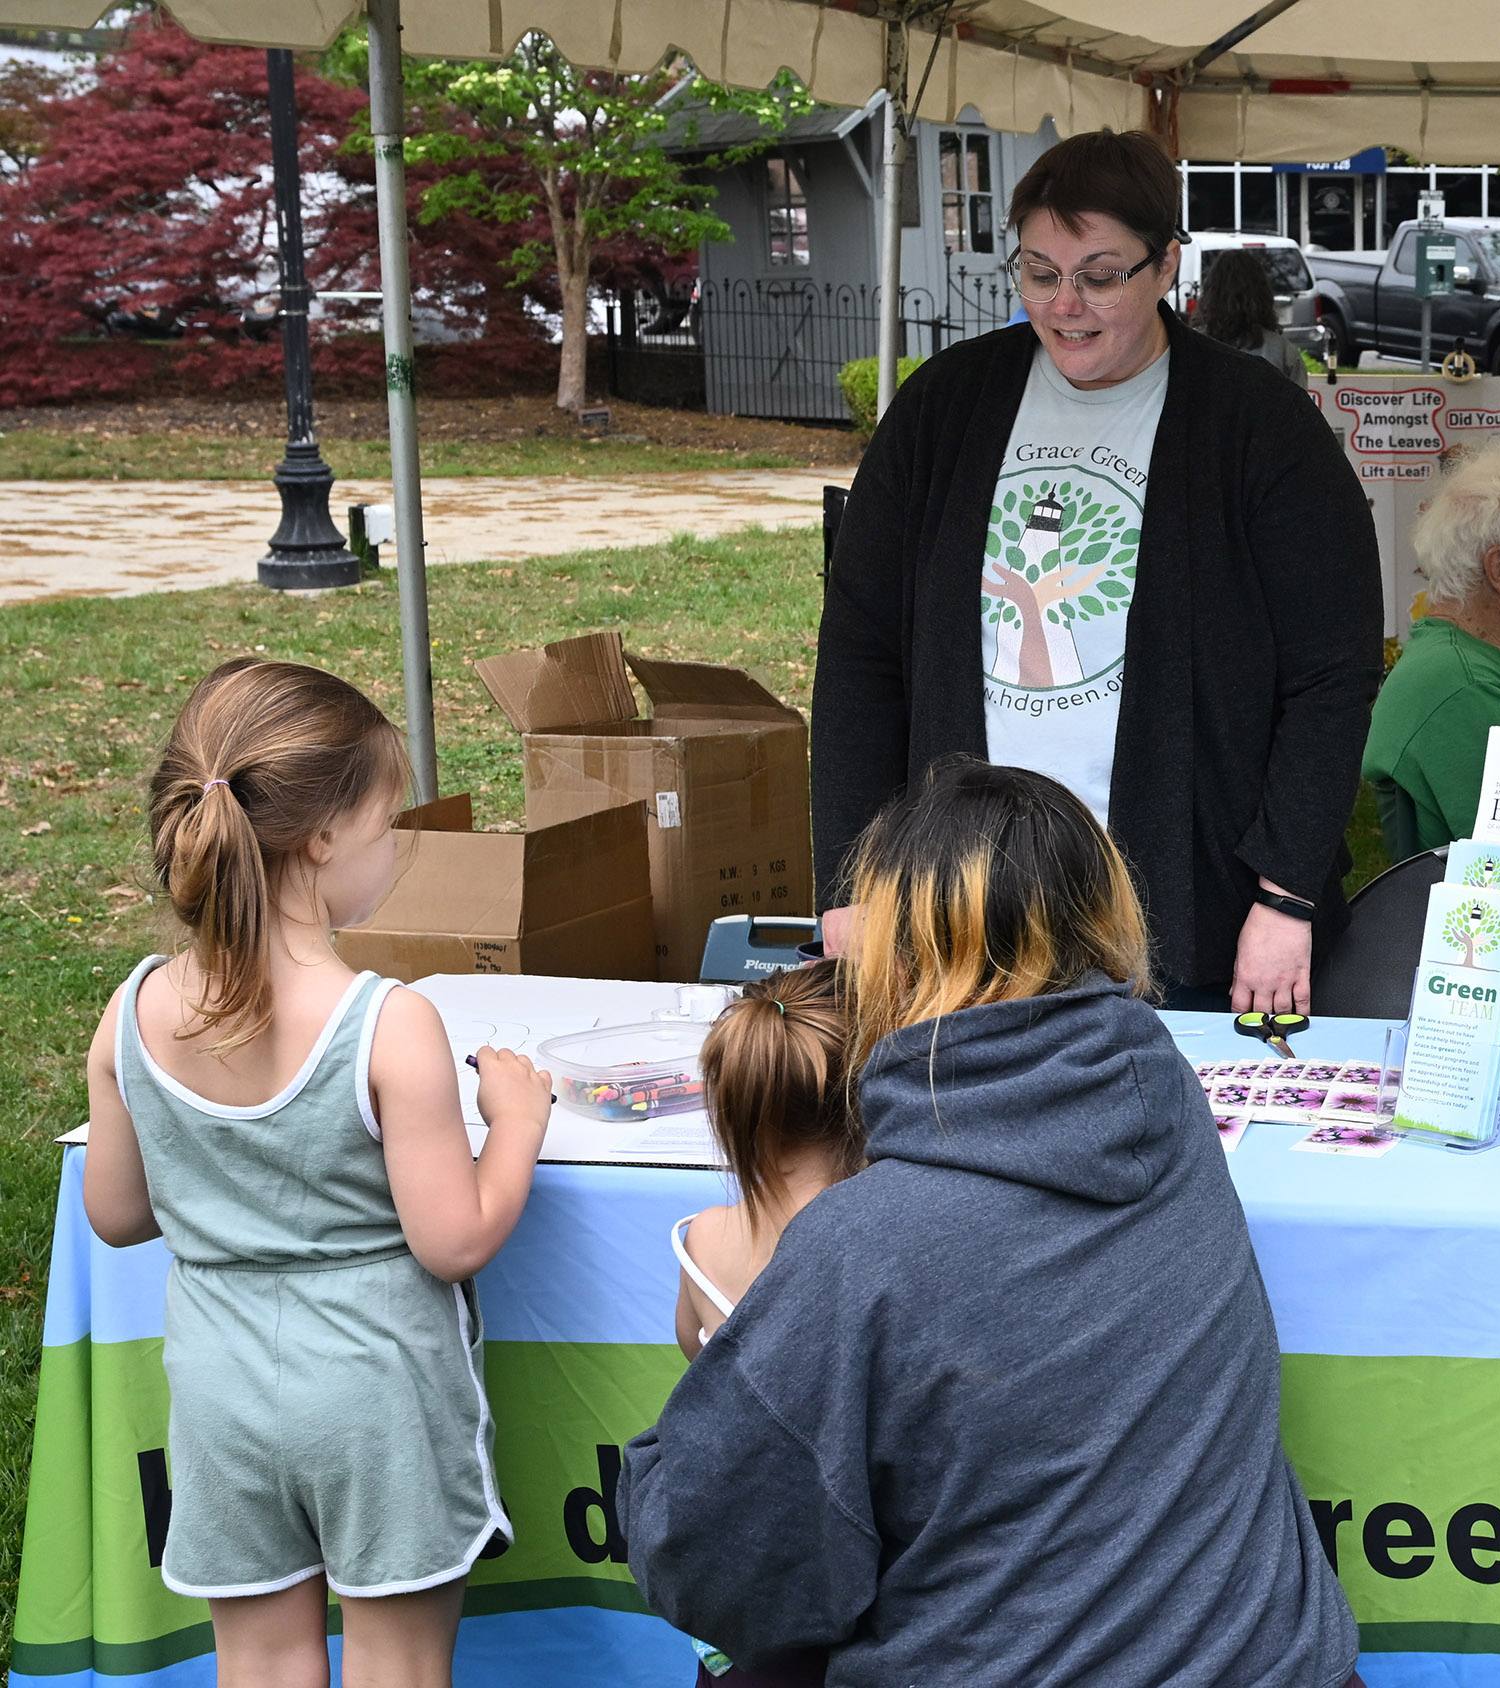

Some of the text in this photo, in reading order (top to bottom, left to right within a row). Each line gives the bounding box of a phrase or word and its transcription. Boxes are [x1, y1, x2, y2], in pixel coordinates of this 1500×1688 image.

[1340, 391, 1441, 406] Discover Life
[1362, 412, 1429, 428] Amongst
[1449, 413, 1472, 426] Did
[1357, 435, 1441, 448] The Leaves
[1015, 443, 1148, 488] Grace Green
[1361, 465, 1430, 478] Lift a Leaf!
[720, 860, 786, 880] N.W.: 9 KGS
[721, 886, 788, 907] G.W.: 10 KGS
[743, 959, 799, 973] Playma
[1428, 975, 1497, 1003] Green
[1448, 999, 1494, 1021] TEAM
[1441, 1020, 1471, 1030] community
[1417, 1025, 1445, 1034] volunteers
[1463, 1031, 1475, 1039] have
[1414, 1041, 1429, 1049] Grace
[1437, 1036, 1448, 1044] help
[1412, 1051, 1444, 1061] educational
[1411, 1060, 1441, 1069] community
[1417, 1069, 1451, 1079] appreciation
[1408, 1077, 1440, 1086] stewardship
[563, 1444, 628, 1563] d
